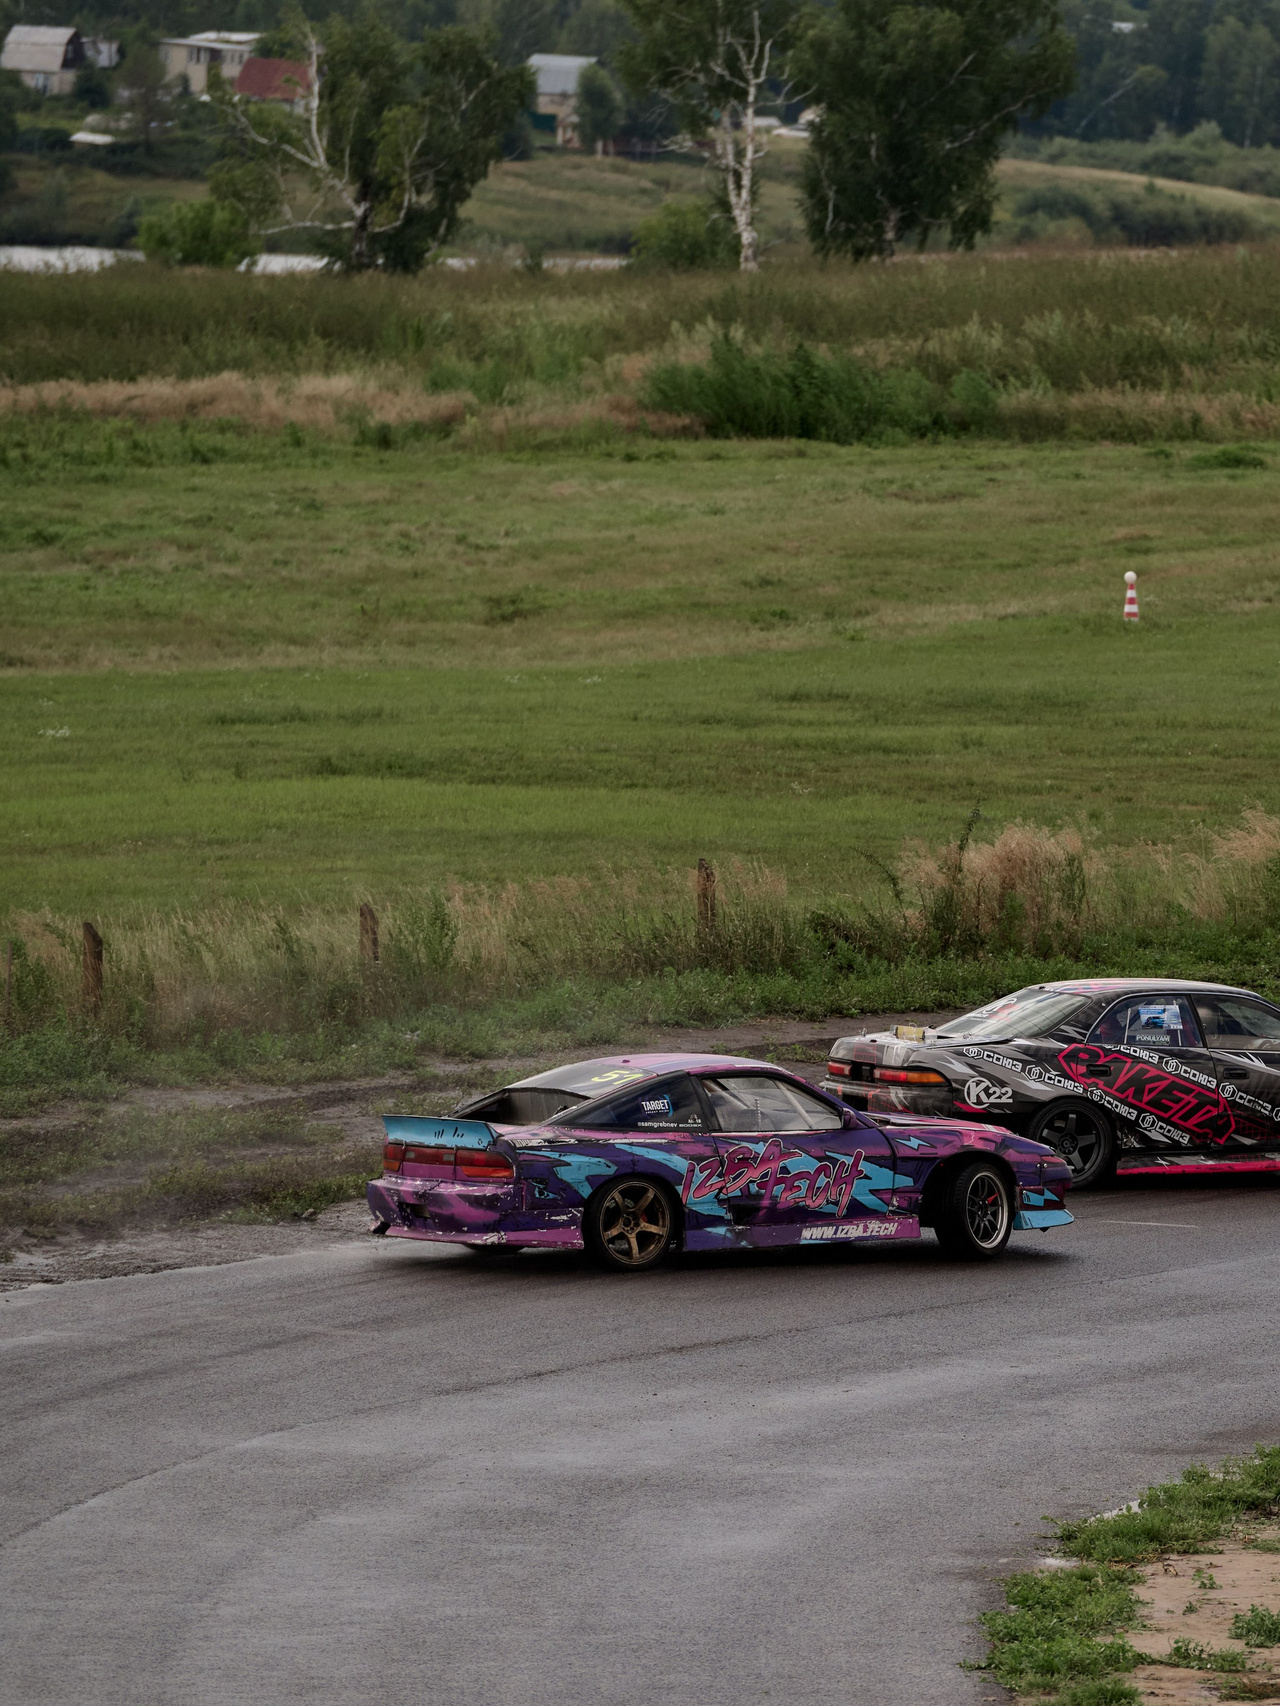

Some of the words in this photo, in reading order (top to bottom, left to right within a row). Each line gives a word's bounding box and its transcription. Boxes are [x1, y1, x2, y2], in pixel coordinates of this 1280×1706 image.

[1136, 1034, 1170, 1042] PONULYAM
[1120, 1045, 1159, 1064] СОЮЗ
[1180, 1066, 1217, 1089] СОЮЗ
[591, 1070, 643, 1085] 51
[641, 1099, 669, 1111] TARGET
[983, 1051, 1022, 1073] СОЮЗ
[1045, 1072, 1083, 1094] СОЮЗ
[1104, 1095, 1137, 1121] СОЮЗ
[1156, 1121, 1190, 1145] СОЮЗ
[756, 1149, 865, 1218] TECH
[802, 1222, 897, 1240] WWW.IZBA.TECH
